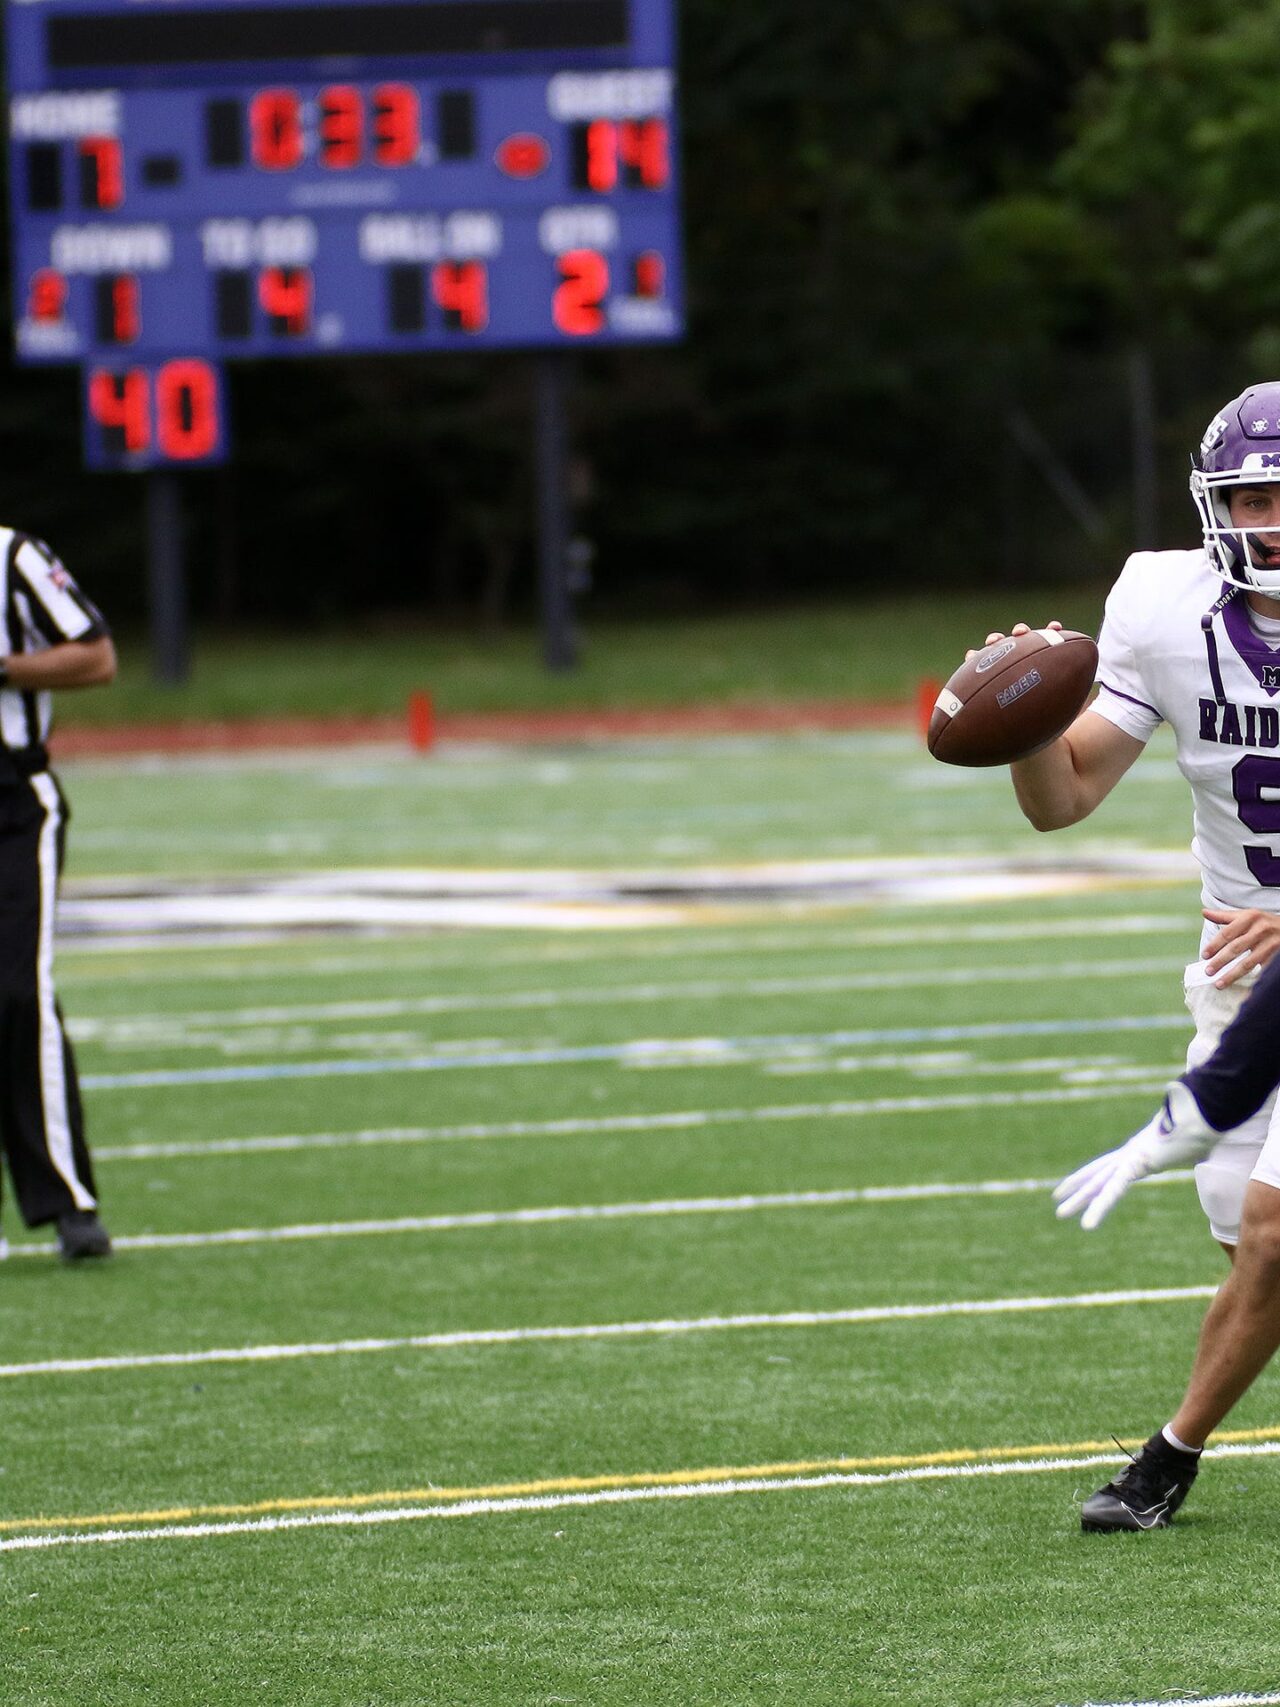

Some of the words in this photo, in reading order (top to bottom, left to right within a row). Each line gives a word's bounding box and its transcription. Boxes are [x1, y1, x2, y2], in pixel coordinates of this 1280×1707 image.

[80, 136, 124, 209] 7
[587, 117, 669, 191] 14
[114, 273, 140, 344] 1
[259, 265, 313, 336] 4
[431, 260, 488, 333] 4
[553, 249, 609, 335] 2
[90, 359, 218, 459] 40
[1261, 454, 1280, 468] M
[996, 668, 1042, 708] RAIDERS
